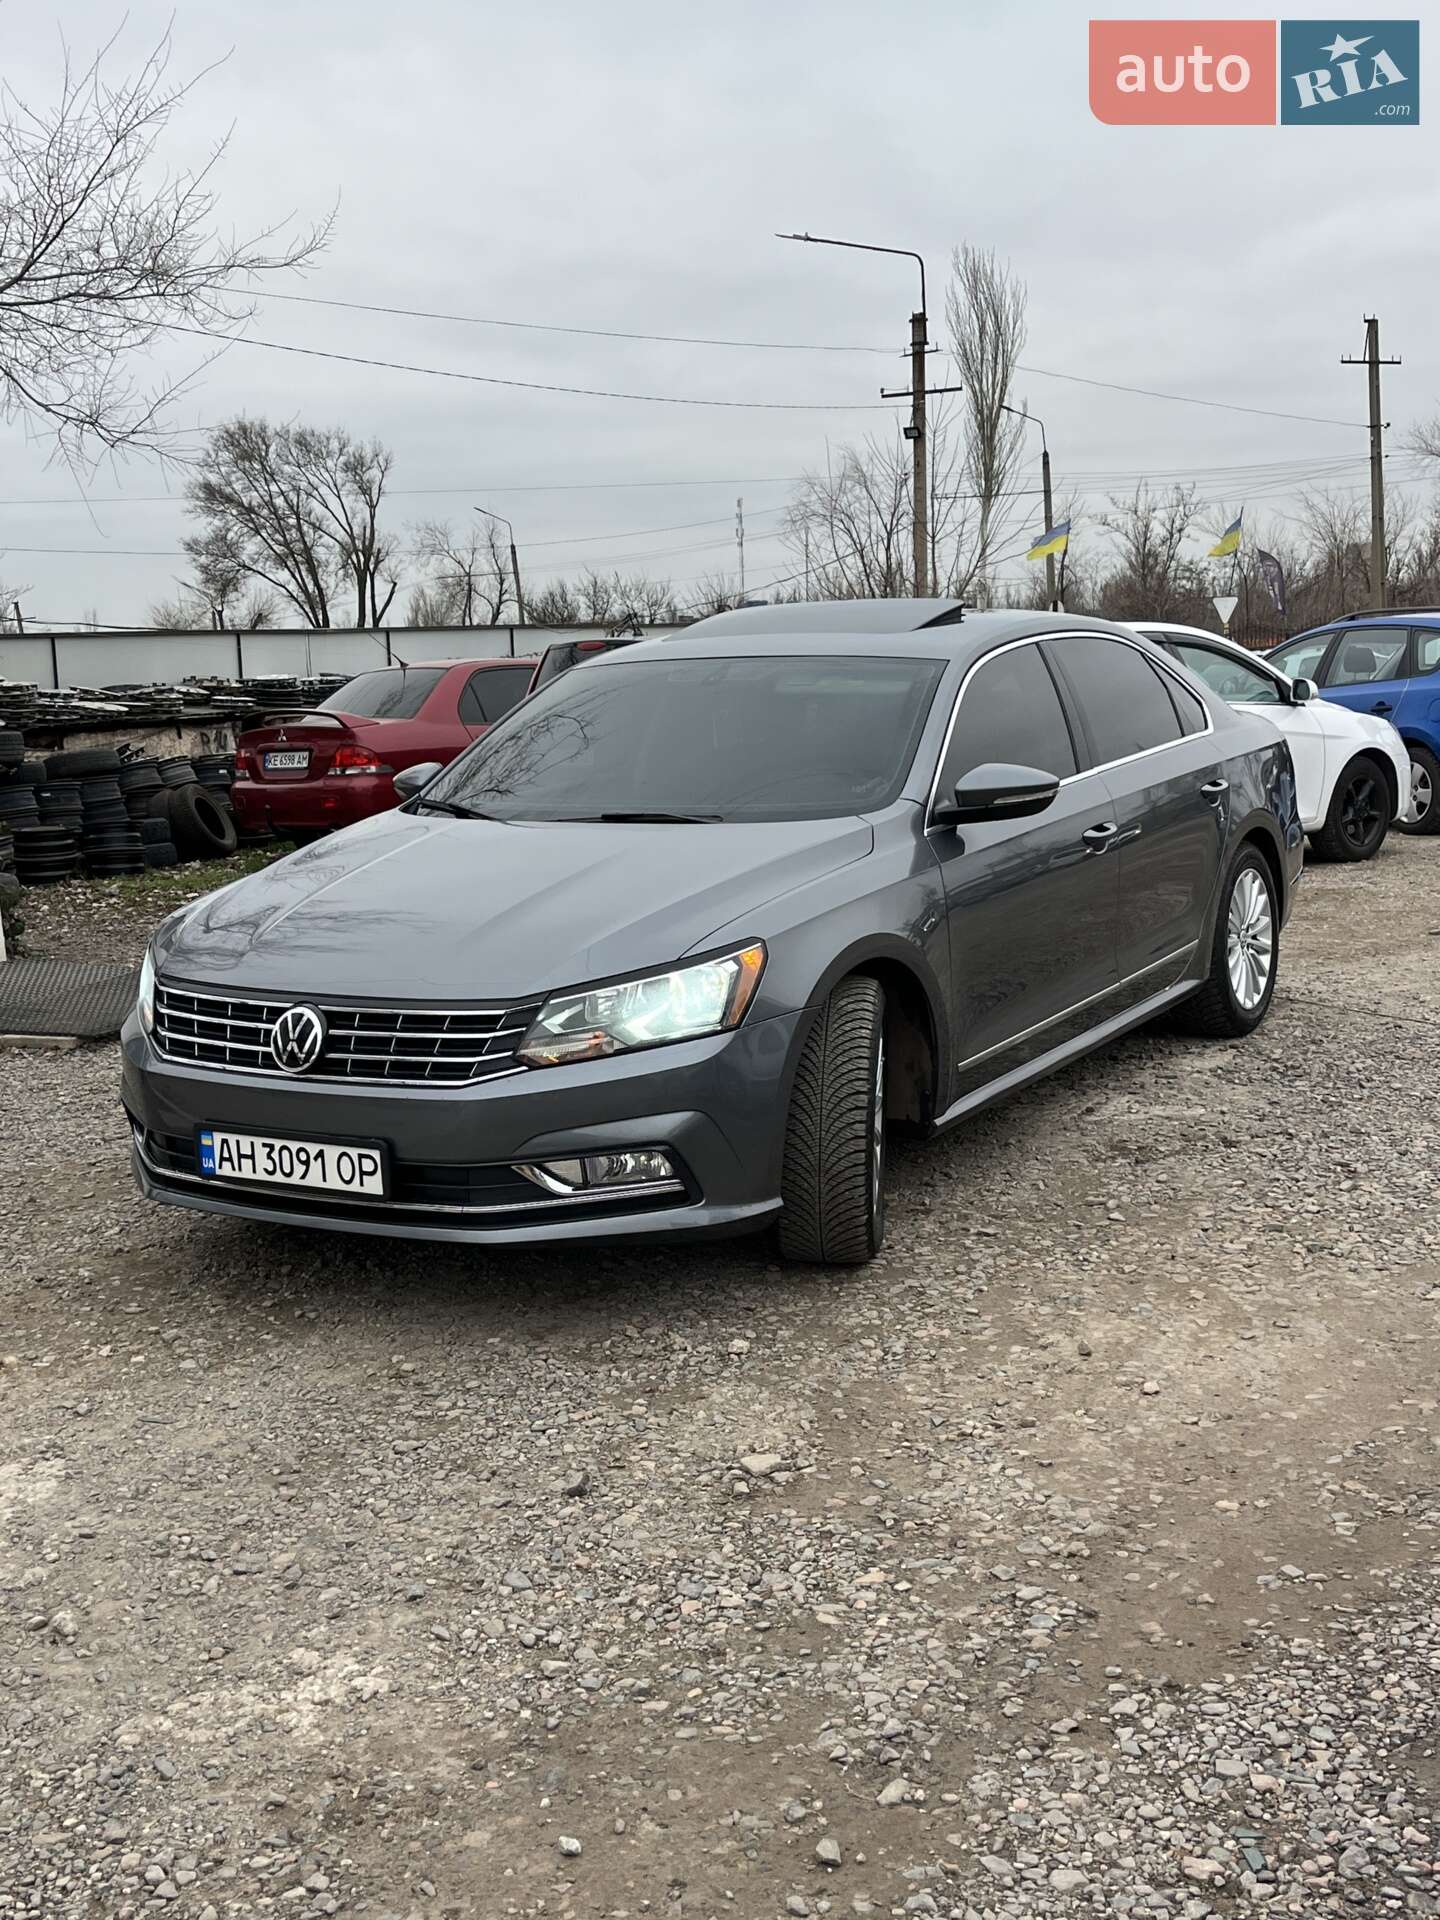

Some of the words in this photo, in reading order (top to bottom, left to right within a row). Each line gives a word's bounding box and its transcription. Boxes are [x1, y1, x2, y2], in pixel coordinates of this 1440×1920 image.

[202, 1157, 214, 1169] UA
[218, 1138, 257, 1174] AH
[261, 1142, 327, 1182] 3091
[337, 1151, 379, 1187] OP
